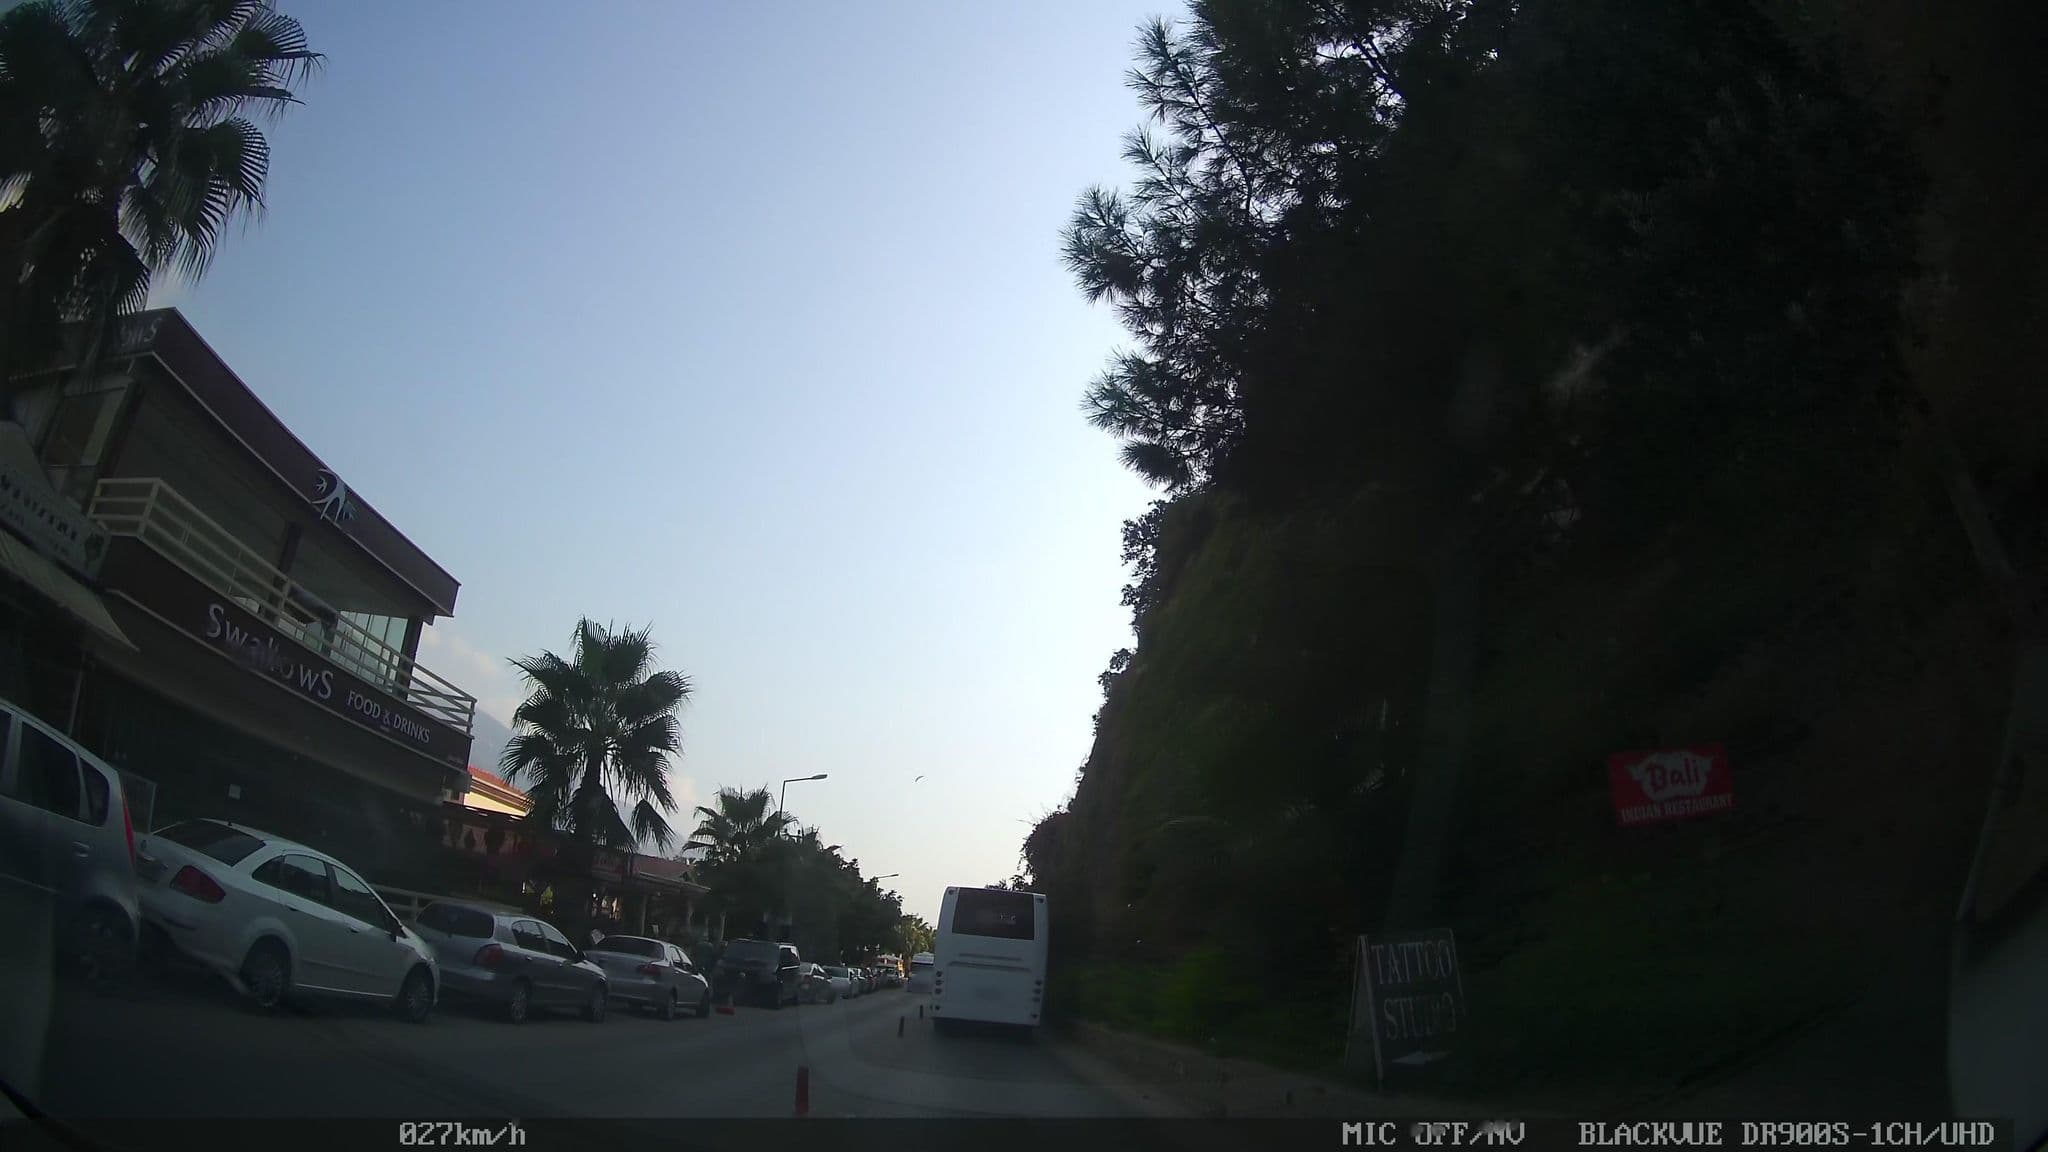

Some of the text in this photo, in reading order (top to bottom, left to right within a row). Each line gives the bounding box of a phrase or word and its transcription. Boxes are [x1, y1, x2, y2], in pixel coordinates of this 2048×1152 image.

[346, 690, 381, 719] FOOD
[393, 713, 431, 744] DRINKS
[1646, 757, 1700, 792] Bali
[1620, 792, 1736, 824] INDIAN RESTAURANT
[1371, 938, 1454, 985] TATTOO
